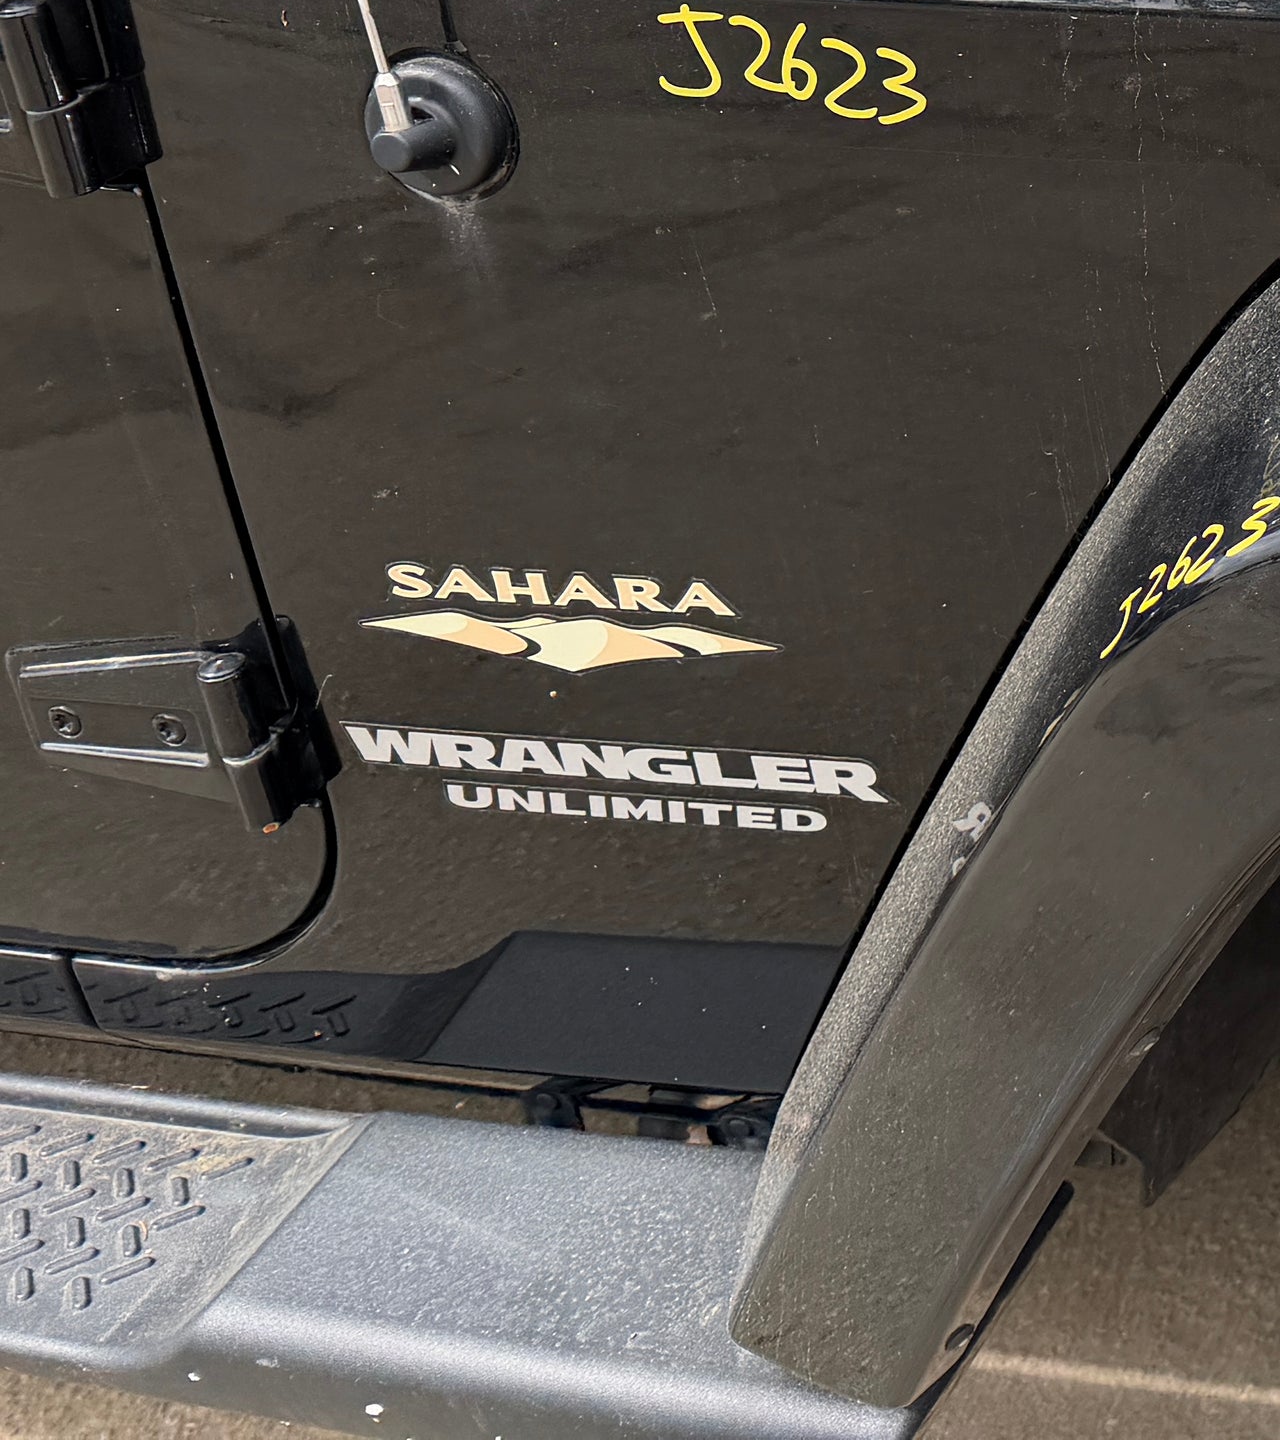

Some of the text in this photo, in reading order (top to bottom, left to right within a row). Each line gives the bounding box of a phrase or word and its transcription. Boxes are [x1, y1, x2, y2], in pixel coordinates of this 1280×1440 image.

[656, 3, 928, 126] J2623
[386, 564, 737, 617] SAHARA
[342, 724, 890, 804] WRANGLER
[446, 783, 829, 833] UNLIMITED
